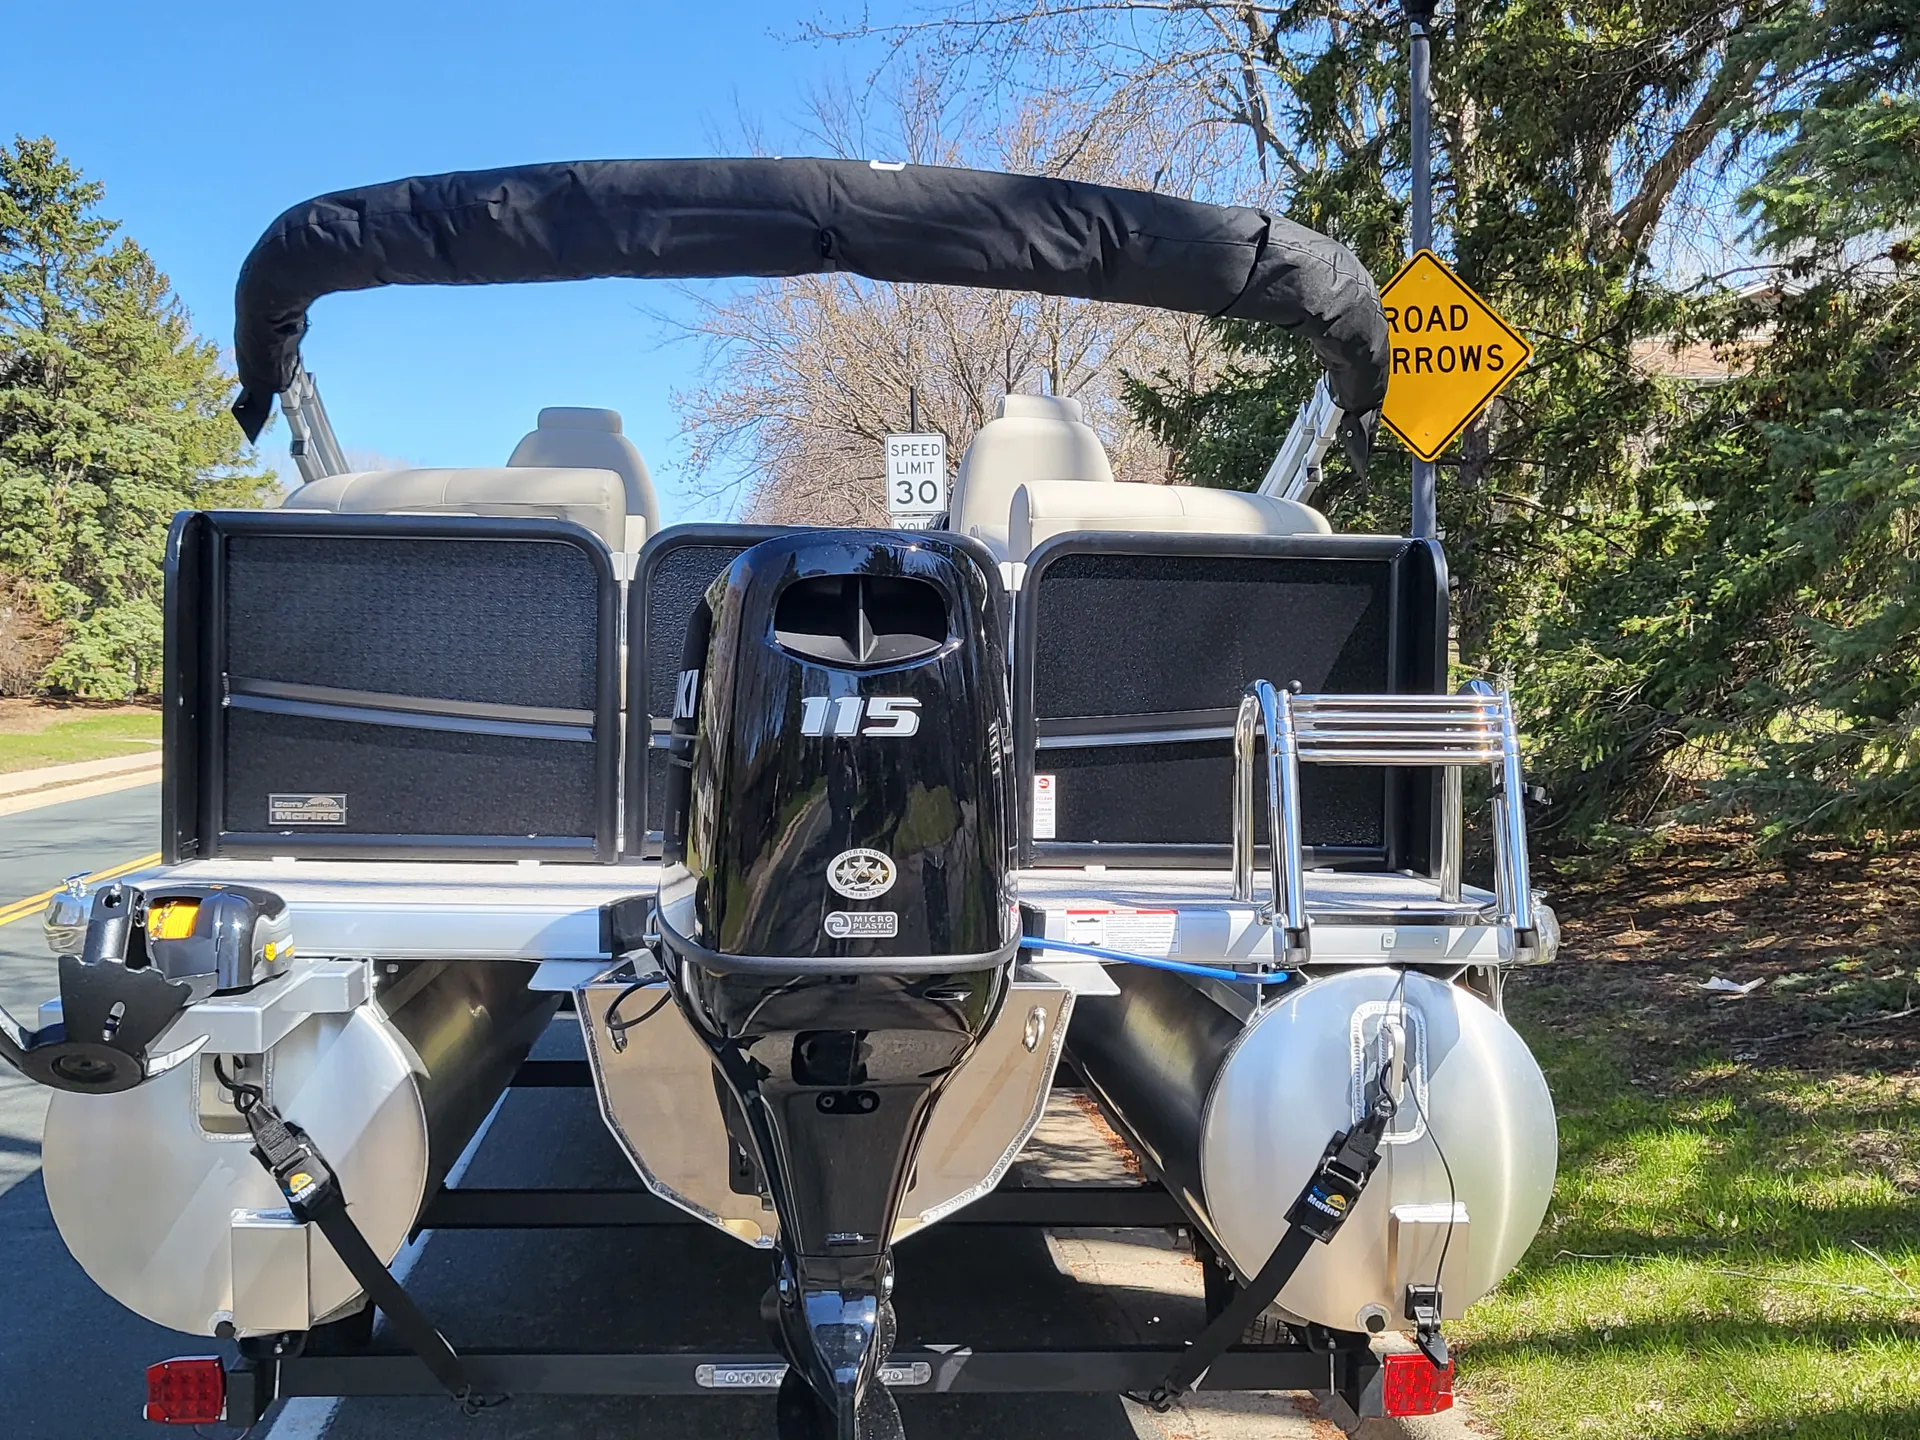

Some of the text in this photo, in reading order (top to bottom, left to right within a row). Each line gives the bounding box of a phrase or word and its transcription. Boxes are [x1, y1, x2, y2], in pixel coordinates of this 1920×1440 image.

[1384, 305, 1468, 333] ROAD
[1389, 344, 1504, 374] RROWS
[890, 444, 940, 456] SPEED
[896, 462, 935, 474] LIMIT
[896, 480, 937, 504] 30
[801, 696, 922, 737] 115
[275, 812, 340, 821] Marine
[839, 849, 887, 861] ULTRA LOW
[853, 915, 893, 923] MICRO
